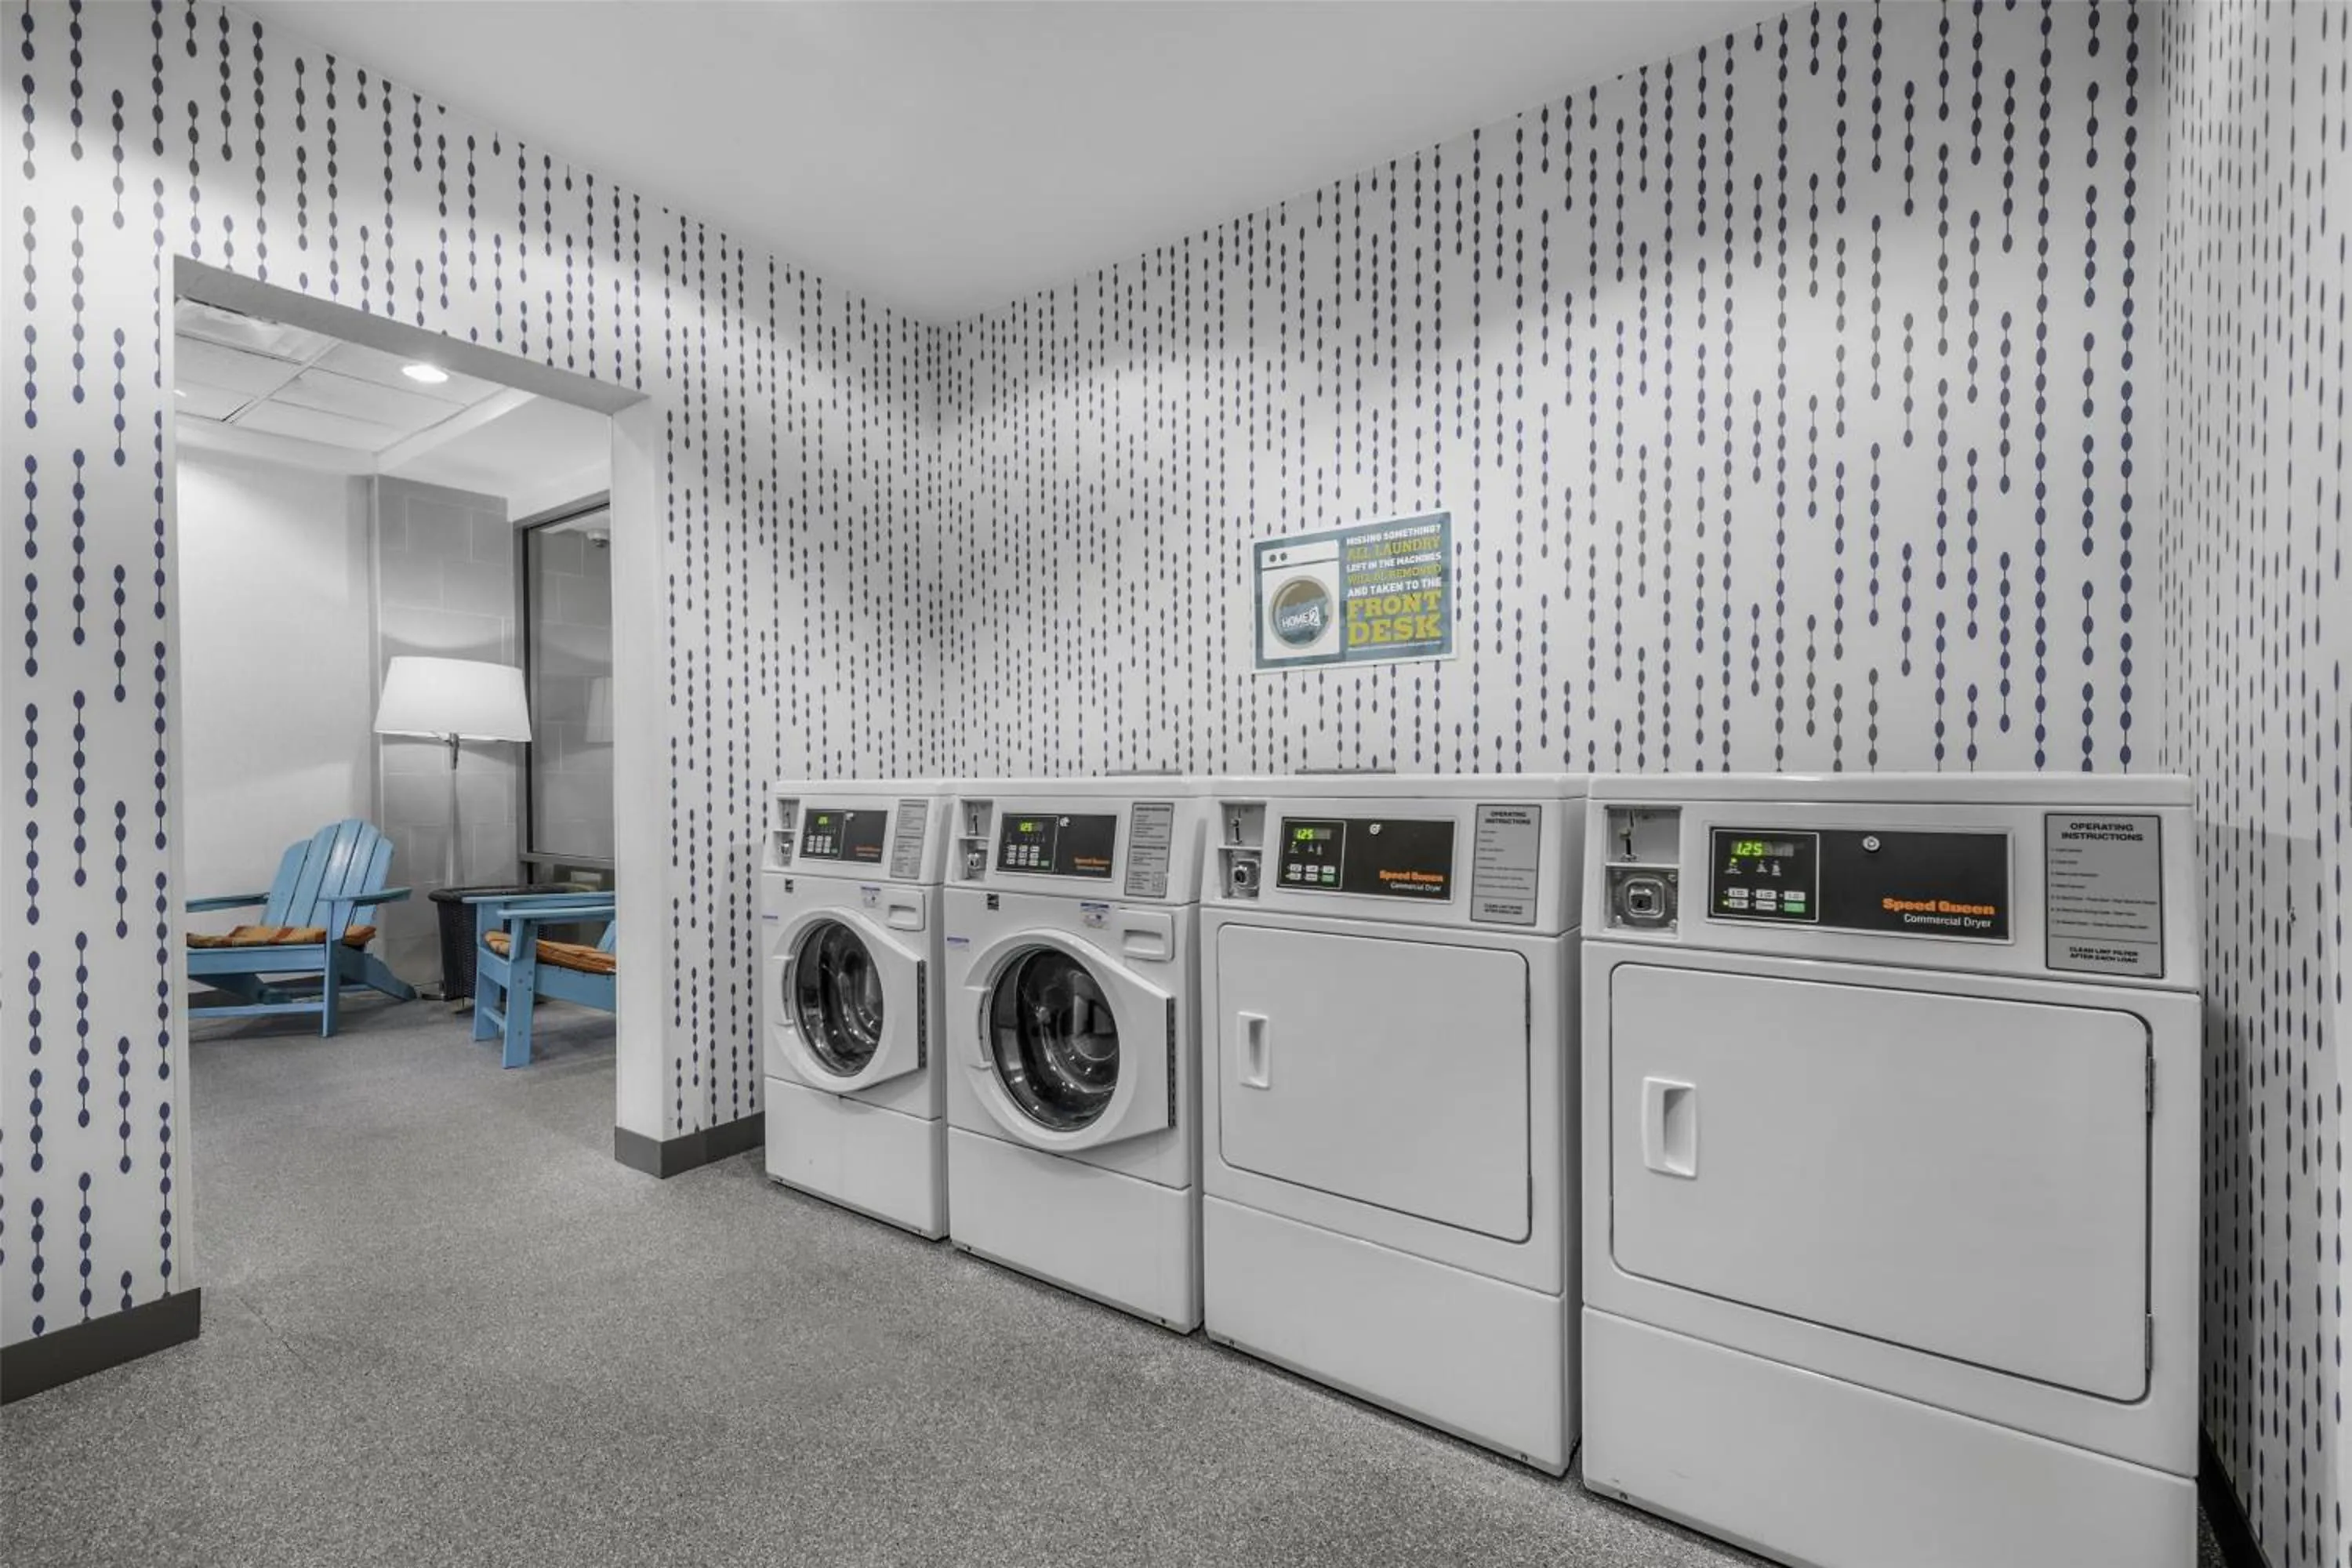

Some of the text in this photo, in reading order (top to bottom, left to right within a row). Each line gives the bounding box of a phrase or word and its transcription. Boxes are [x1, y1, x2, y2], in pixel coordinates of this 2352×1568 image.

[1346, 523, 1441, 546] MISSING SOMETHING?
[1374, 535, 1441, 557] LAUNDRY
[1346, 551, 1442, 573] LEFT IN THE MACHINES
[1347, 576, 1442, 597] AND TAKEN TO THE
[1347, 589, 1442, 620] FRONT
[1347, 612, 1442, 646] DESK
[2070, 822, 2133, 832] OPERATING
[2061, 832, 2143, 842] INSTRUCTIONS
[1379, 869, 1443, 883] Speed Queen
[1390, 881, 1442, 893] Commercial Dryer
[1882, 897, 1995, 915] Speed Queen
[1904, 913, 1992, 929] Commercial Dryer
